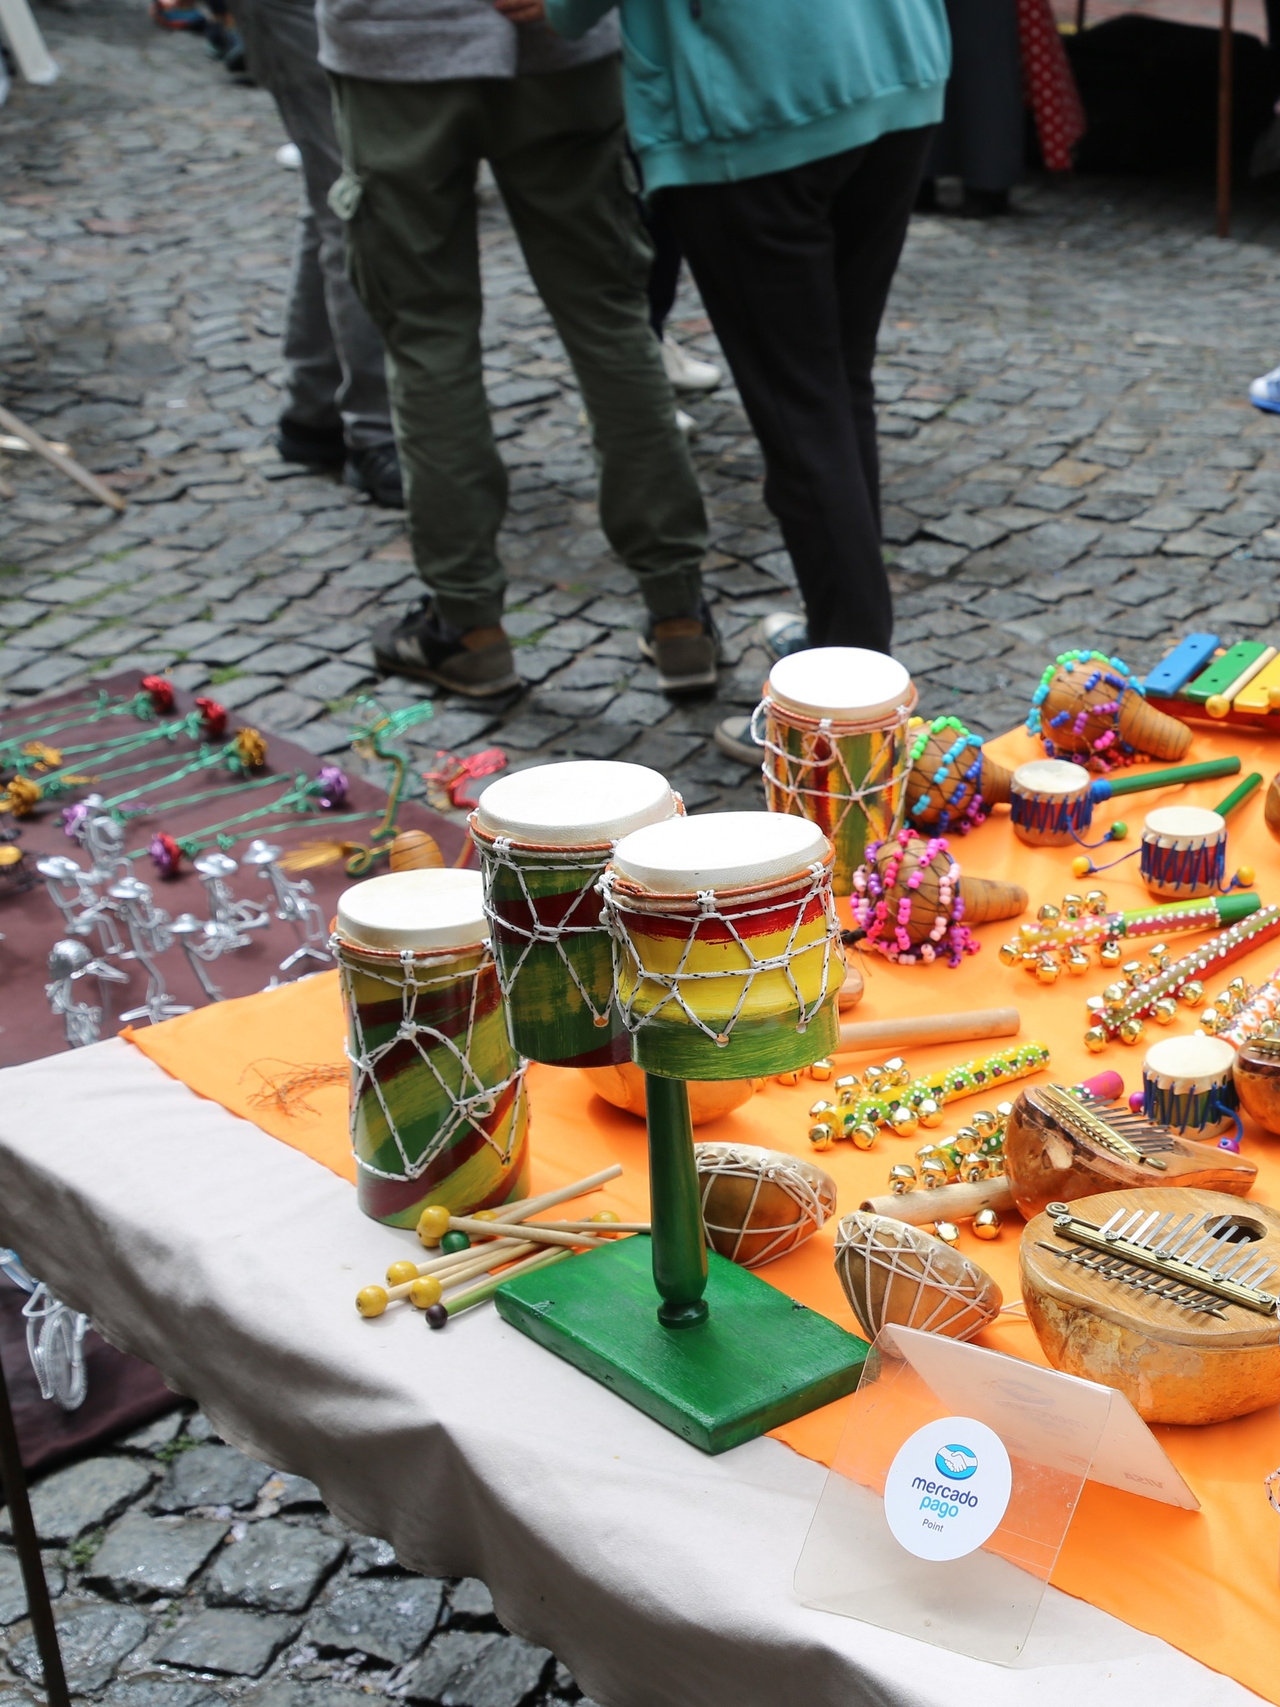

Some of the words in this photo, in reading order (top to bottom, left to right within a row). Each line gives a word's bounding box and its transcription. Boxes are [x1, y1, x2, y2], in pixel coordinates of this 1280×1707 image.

[911, 1477, 978, 1507] mercado
[919, 1496, 959, 1518] pago
[922, 1518, 944, 1532] Point
